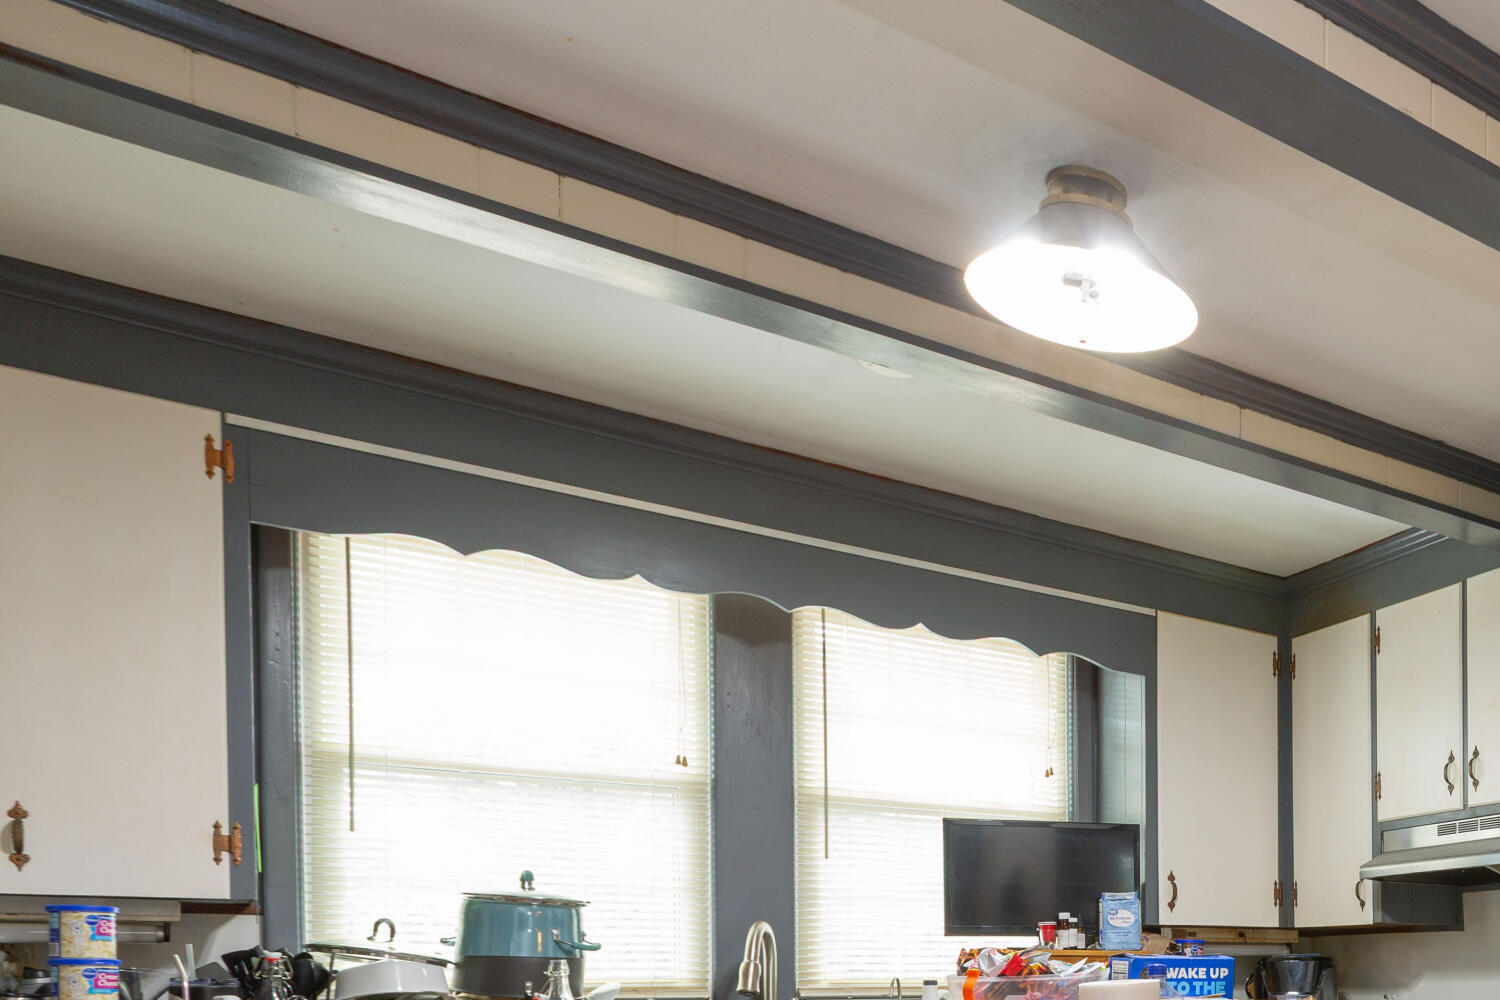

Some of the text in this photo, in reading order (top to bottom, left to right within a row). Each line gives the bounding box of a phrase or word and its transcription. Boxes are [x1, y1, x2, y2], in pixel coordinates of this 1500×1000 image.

[1166, 967, 1229, 979] WAKE UP
[1168, 981, 1226, 995] TO THE
